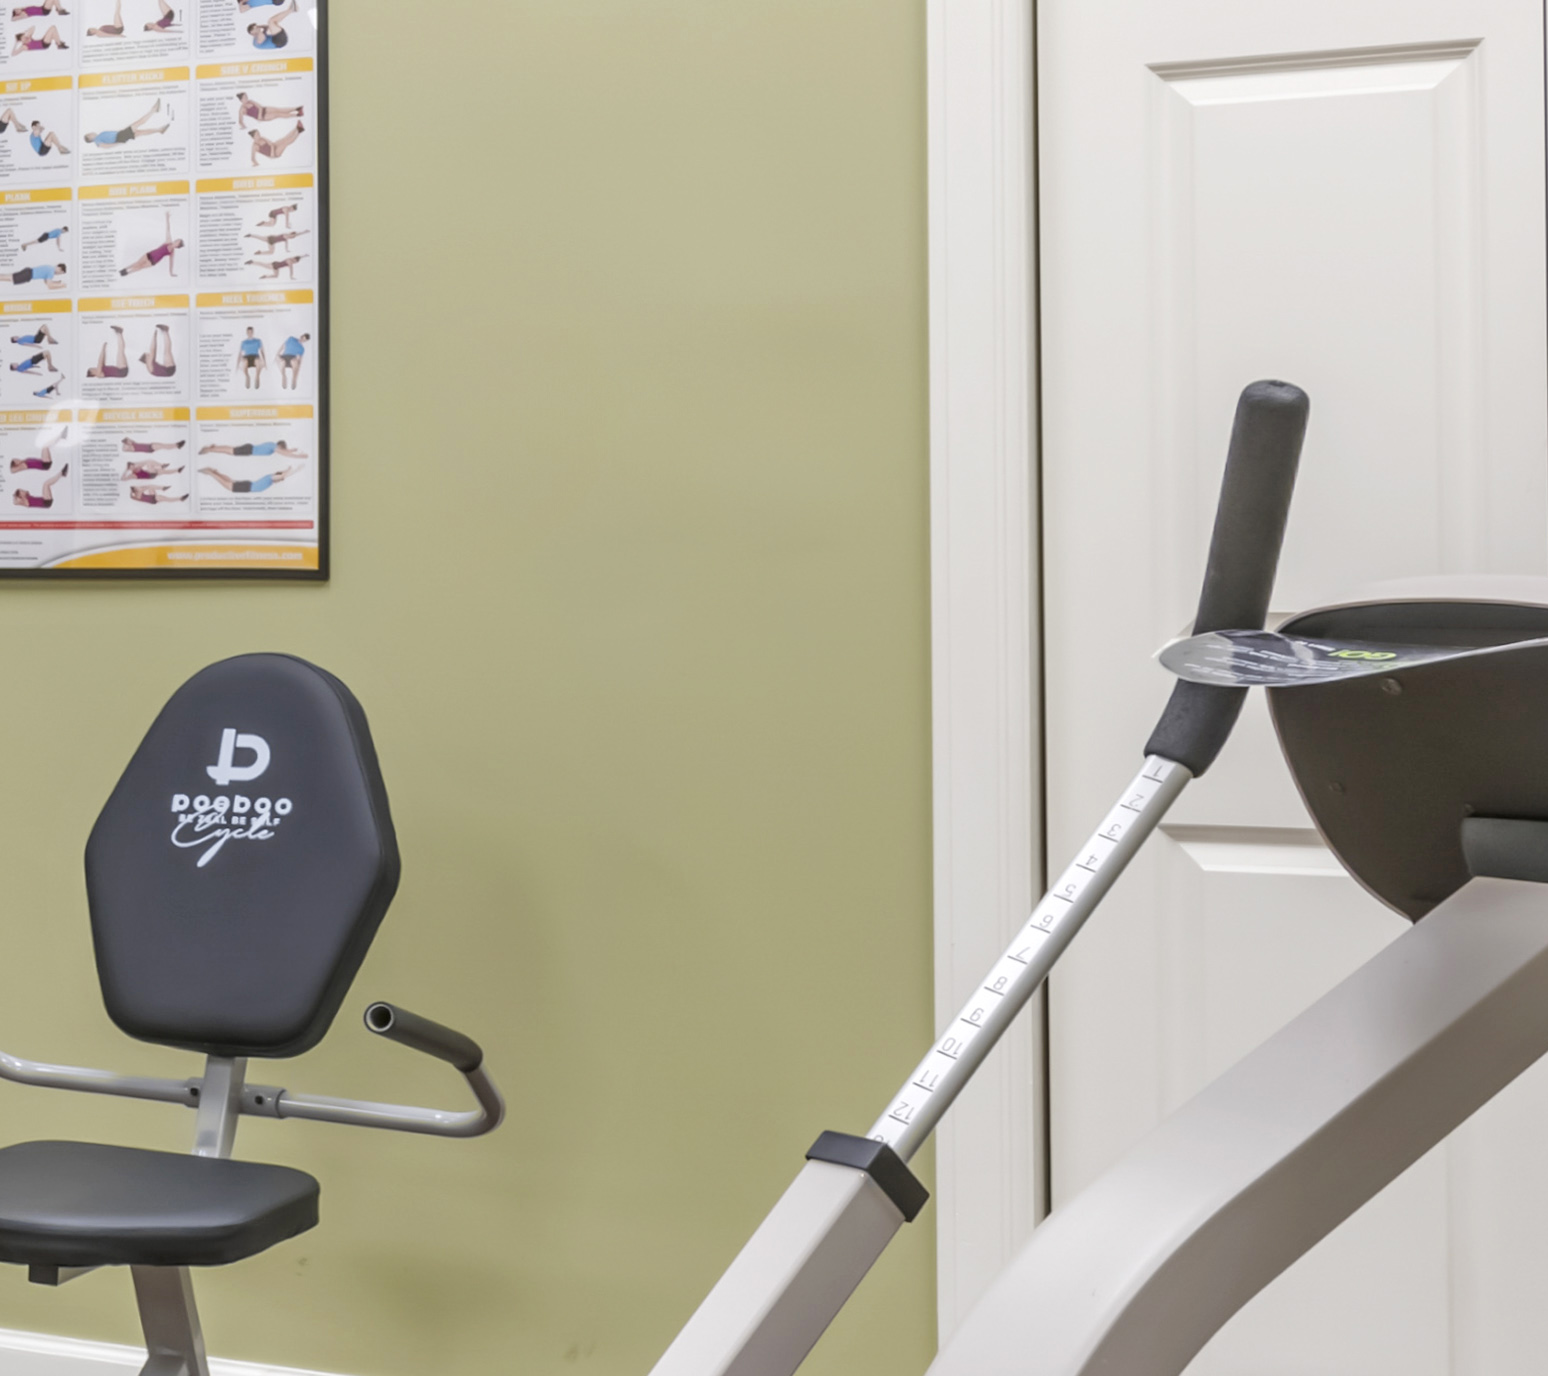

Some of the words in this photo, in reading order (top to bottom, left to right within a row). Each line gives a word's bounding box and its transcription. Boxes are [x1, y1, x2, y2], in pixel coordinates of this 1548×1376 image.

[1151, 764, 1163, 779] 1
[1128, 793, 1146, 808] 2
[1107, 823, 1123, 838] 3
[1085, 853, 1099, 868] 4
[1064, 883, 1078, 898] 5
[1039, 914, 1054, 930] 6
[1015, 946, 1032, 960] 7
[993, 976, 1008, 992] 8
[969, 1007, 985, 1023] 9
[941, 1037, 965, 1057] 10
[919, 1069, 940, 1088] 11
[893, 1101, 916, 1121] 12
